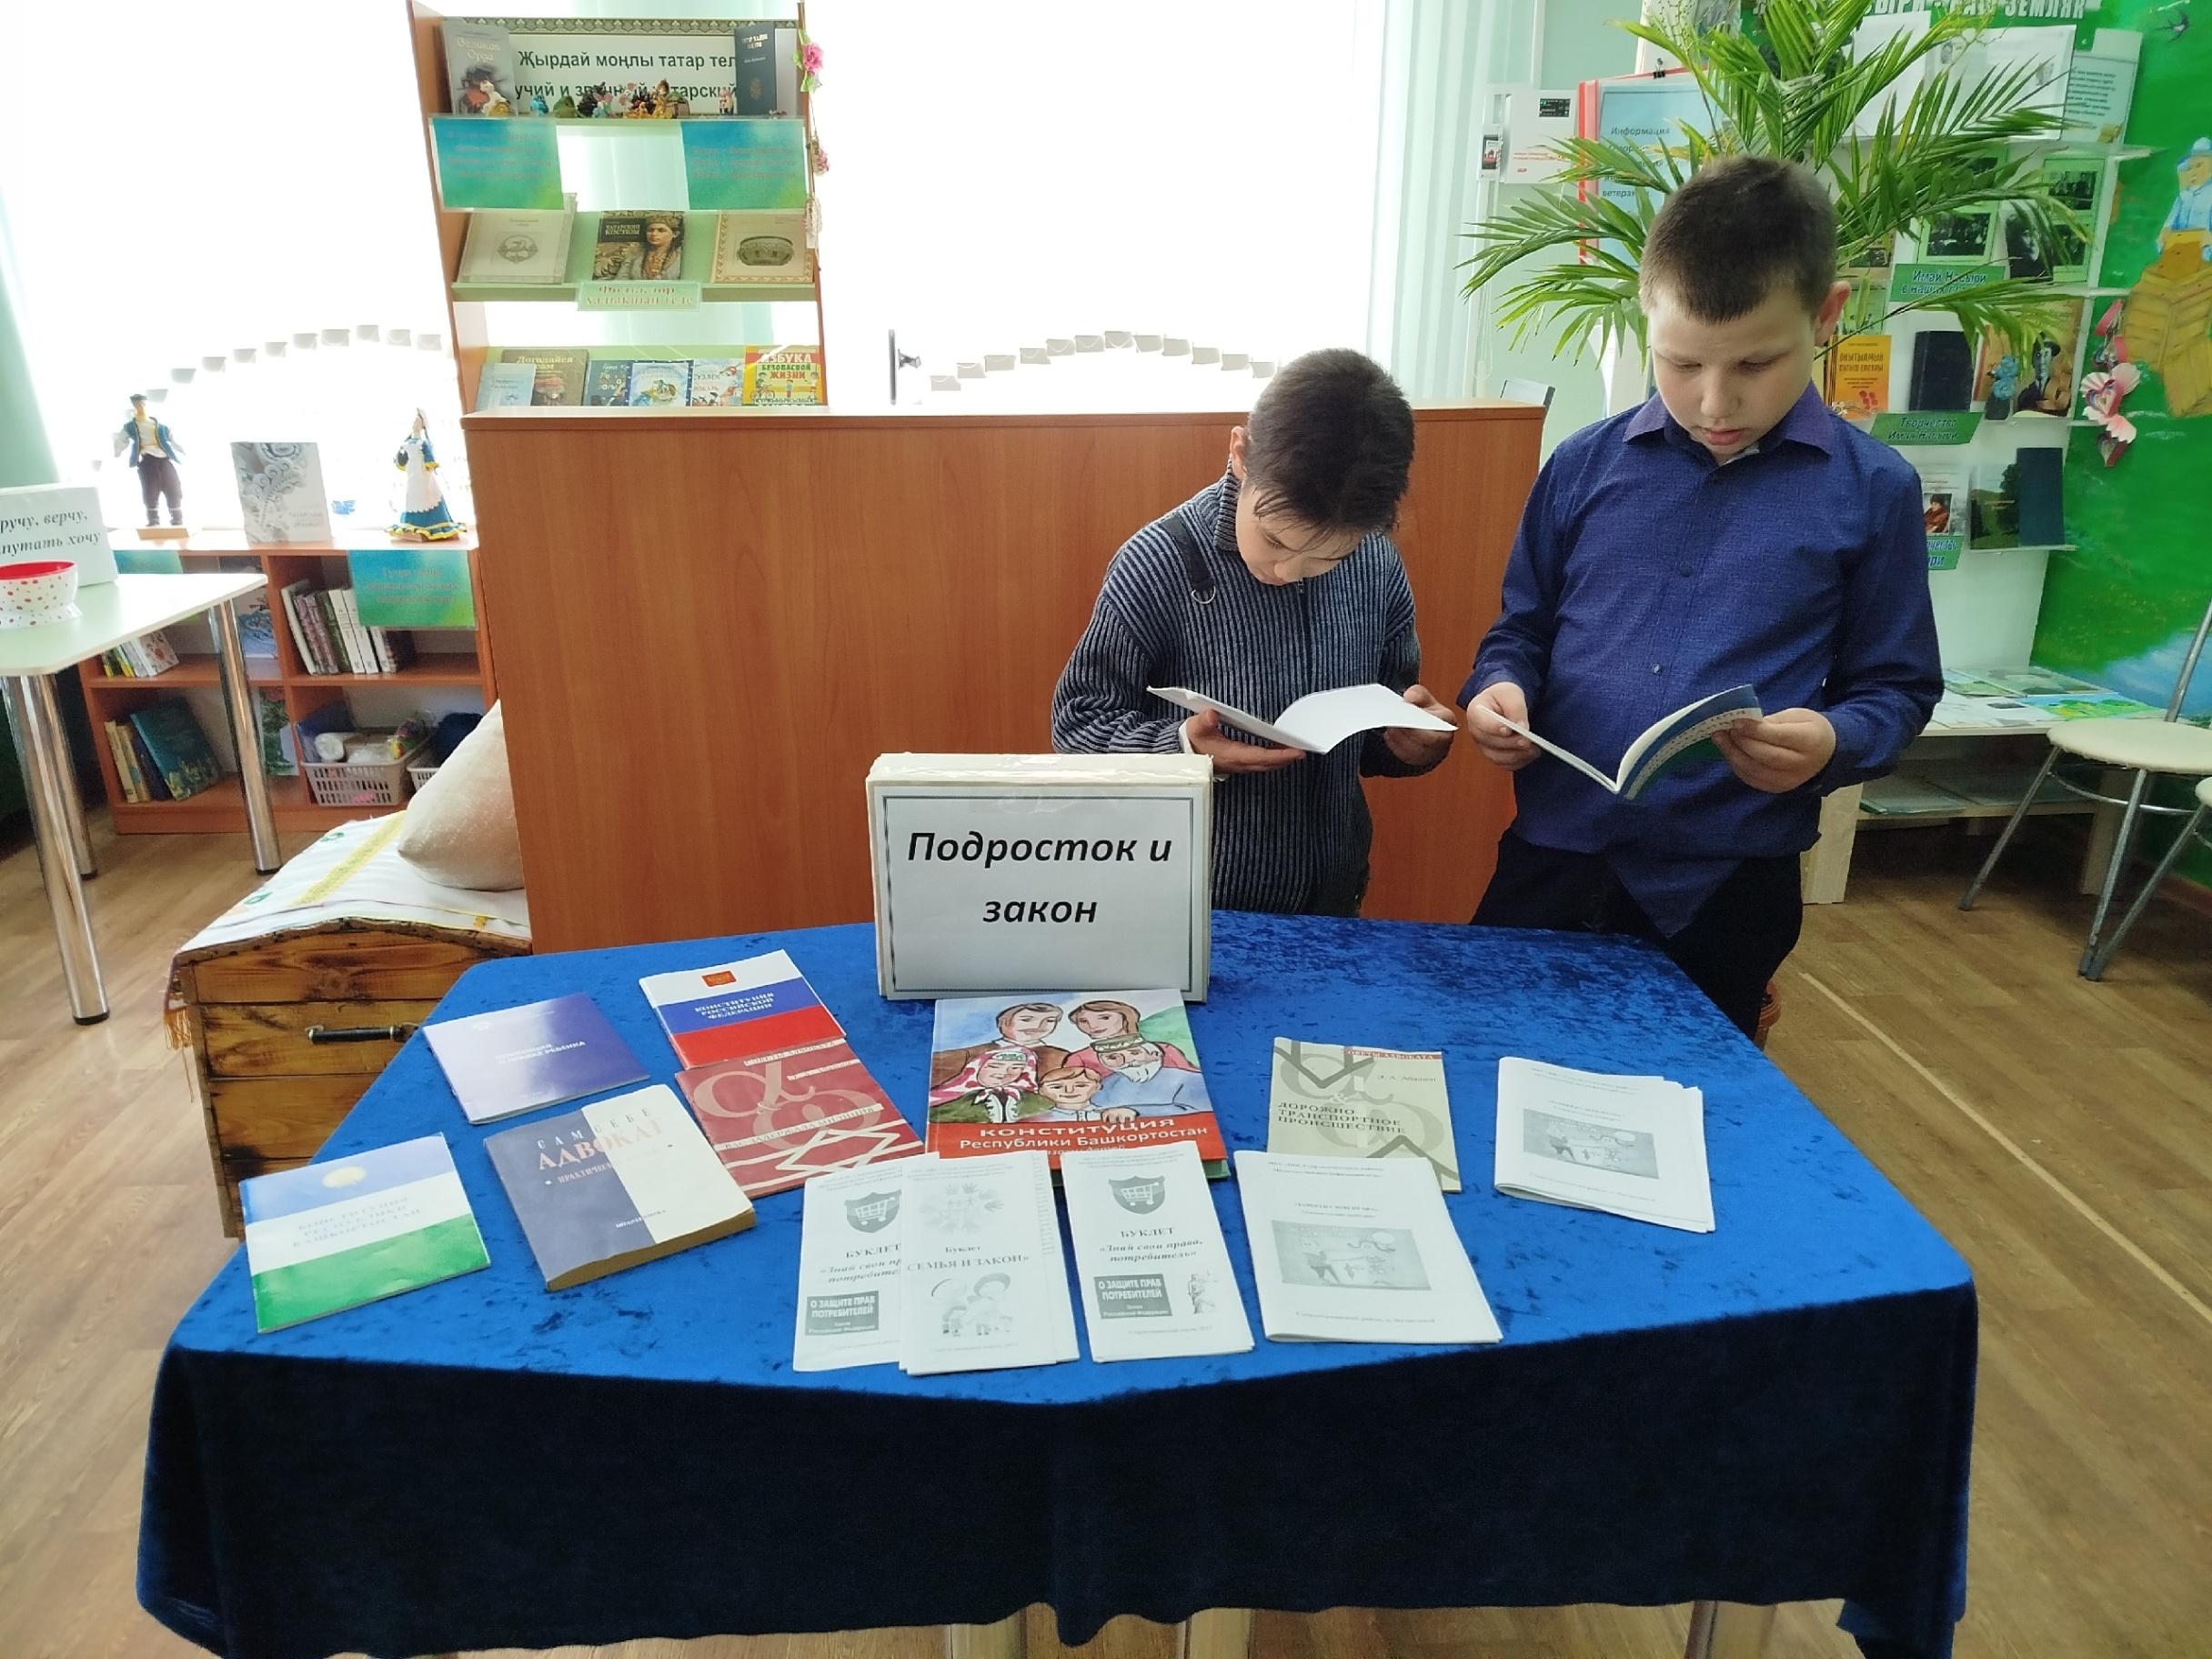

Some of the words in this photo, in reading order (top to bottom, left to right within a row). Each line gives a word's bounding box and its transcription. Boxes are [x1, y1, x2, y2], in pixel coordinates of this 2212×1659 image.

[659, 55, 705, 70] татар
[561, 85, 570, 96] и
[1611, 126, 1670, 136] Информация
[769, 371, 806, 379] ЖИЗНИ
[44, 510, 87, 527] верчу,
[0, 538, 63, 558] путать
[67, 532, 100, 546] хочу
[908, 830, 1137, 869] Подросток
[1150, 840, 1172, 861] и
[982, 900, 1098, 923] закон
[1278, 1101, 1355, 1115] ДОРОЖНО
[1278, 1109, 1402, 1126] ТРАНСПОРТНОЕ
[1278, 1116, 1405, 1133] ПРОИСШЕСТВИЕ
[980, 1119, 1175, 1137] КОНСТИТУЦИЯ
[538, 1130, 585, 1150] САМ
[539, 1119, 662, 1171] АДВОКАТ
[960, 1137, 1071, 1150] Республики
[1077, 1126, 1208, 1147] Башкортостан
[1121, 1227, 1174, 1238] БУКЛЕТ
[1098, 1281, 1106, 1290] О
[1107, 1279, 1140, 1290] ЗАЩИТЕ
[1141, 1278, 1162, 1288] ПРАВ
[809, 1300, 818, 1310] О
[819, 1297, 853, 1309] ЗАЩИТЕ
[854, 1295, 876, 1305] ПРАВ
[1101, 1288, 1162, 1301] ПОТРЕБИТЕЛЕЙ
[811, 1302, 874, 1318] ПОТРЕБИТЕЛЕЙ
